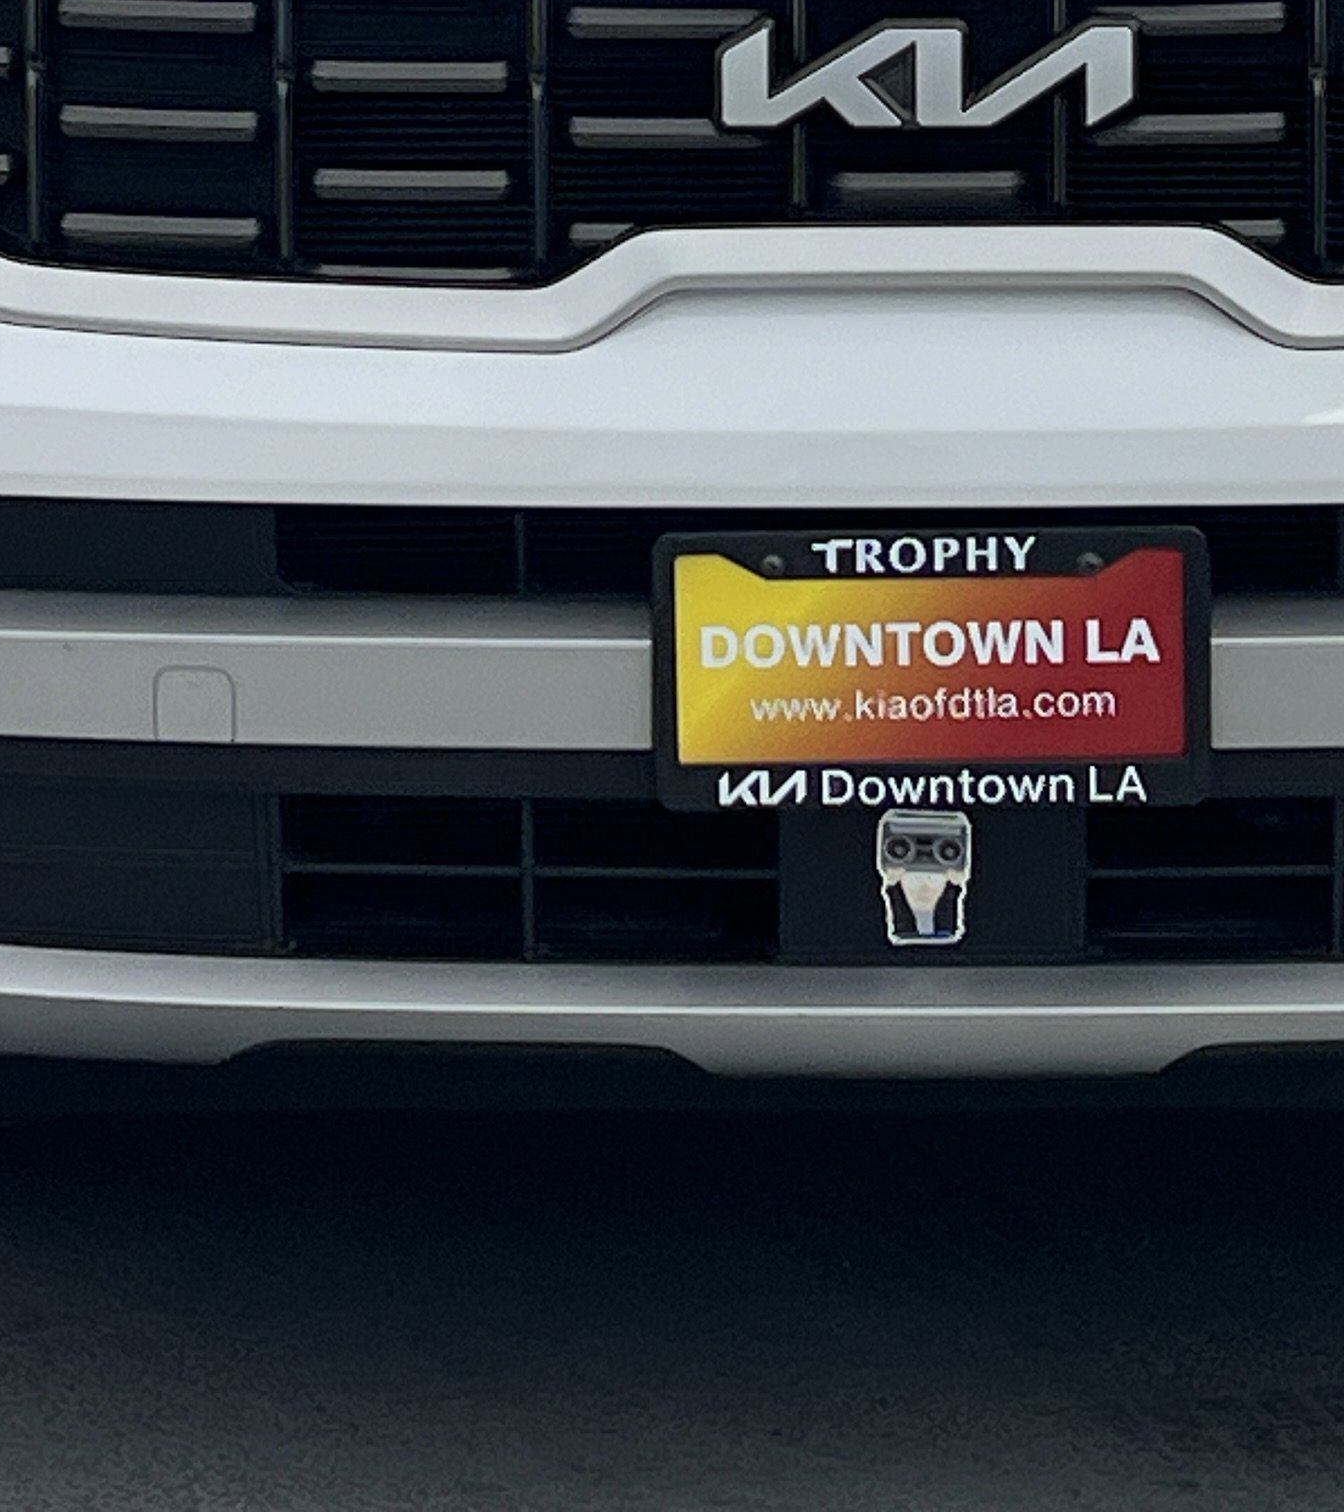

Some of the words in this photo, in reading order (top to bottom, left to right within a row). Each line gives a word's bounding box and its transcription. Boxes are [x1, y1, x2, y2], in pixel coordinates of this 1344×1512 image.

[718, 24, 1136, 128] KIA
[811, 536, 1036, 574] TROPHY
[700, 619, 1064, 669] DOWNTOWN
[1085, 617, 1161, 664] LA
[750, 687, 1116, 723] www.kiaofdtla.com
[718, 769, 807, 806] KIA
[821, 767, 1075, 806] Downtown
[1089, 765, 1147, 803] LA
